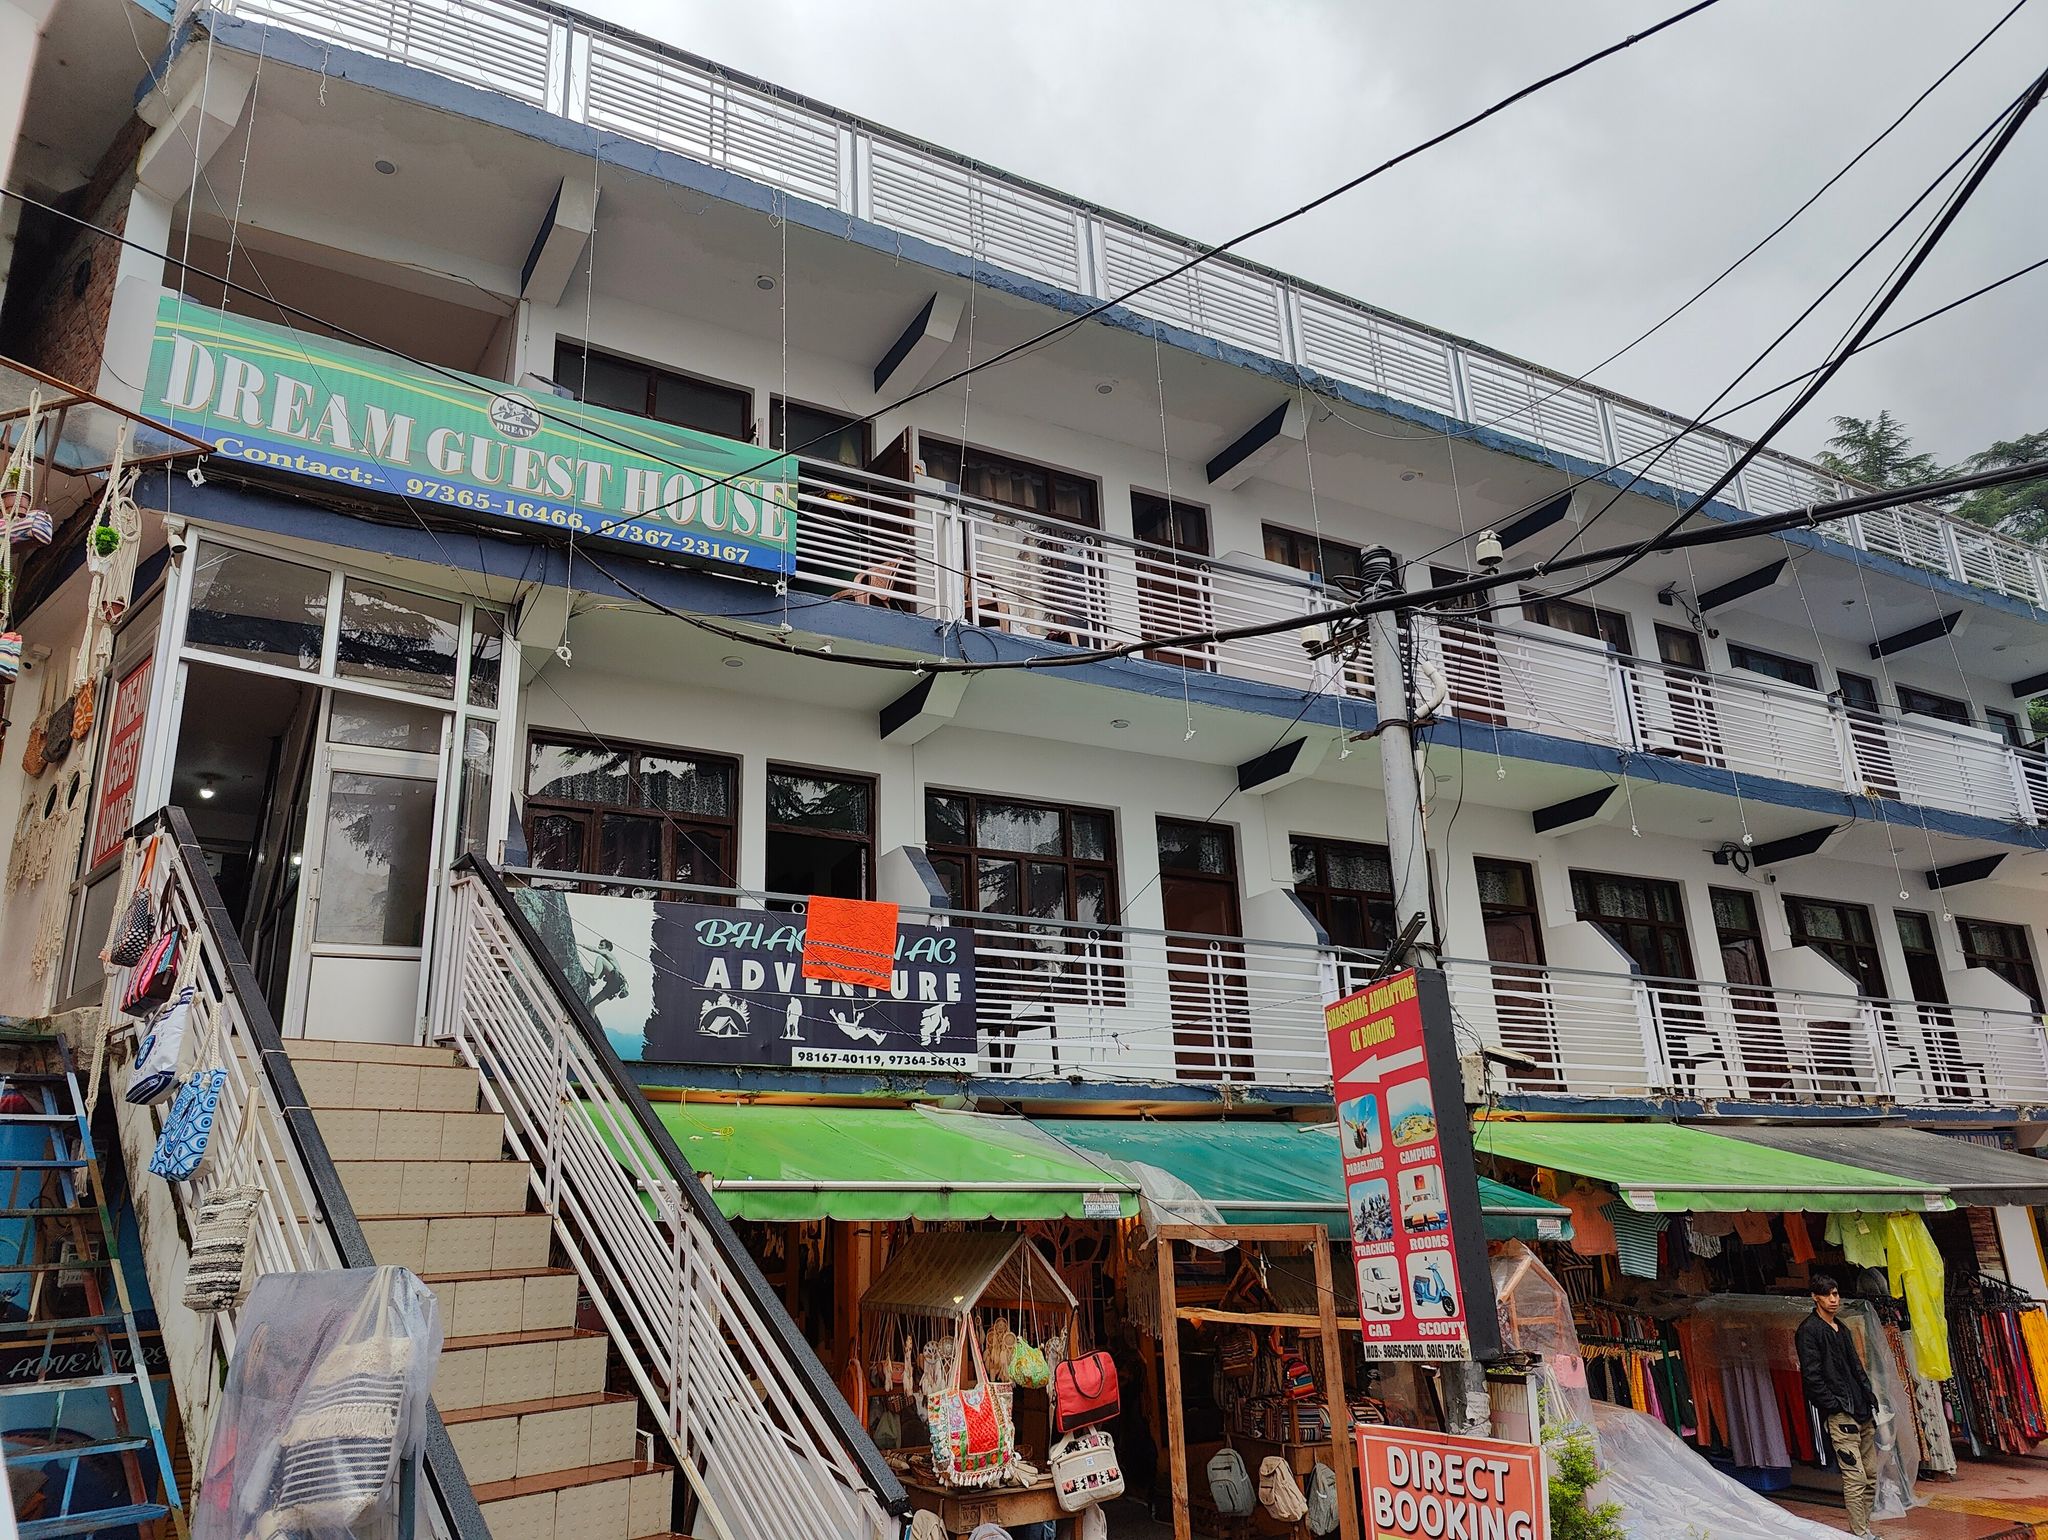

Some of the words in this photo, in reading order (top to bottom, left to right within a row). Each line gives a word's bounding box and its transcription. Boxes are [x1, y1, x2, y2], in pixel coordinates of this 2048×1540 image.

[161, 333, 416, 465] DREAM
[425, 427, 612, 508] GUEST
[621, 466, 789, 541] HOUSE
[496, 422, 533, 437] DREAM
[215, 437, 386, 484] Contact:-
[406, 478, 590, 532] 97365-16466,
[600, 520, 751, 563] 97367-23167
[108, 727, 141, 792] GUEST
[1361, 1015, 1396, 1048] BOOKING
[797, 1052, 885, 1066] 98167-40119,
[888, 1054, 967, 1067] 97364-56143
[1400, 1145, 1436, 1165] CAMPING
[1355, 1241, 1395, 1257] TRACKING
[1409, 1234, 1449, 1250] ROOMS
[1368, 1323, 1391, 1337] CAR
[1418, 1321, 1465, 1336] SCOOTY
[1386, 1446, 1509, 1502] DIRECT
[1372, 1486, 1532, 1540] BOOKING
